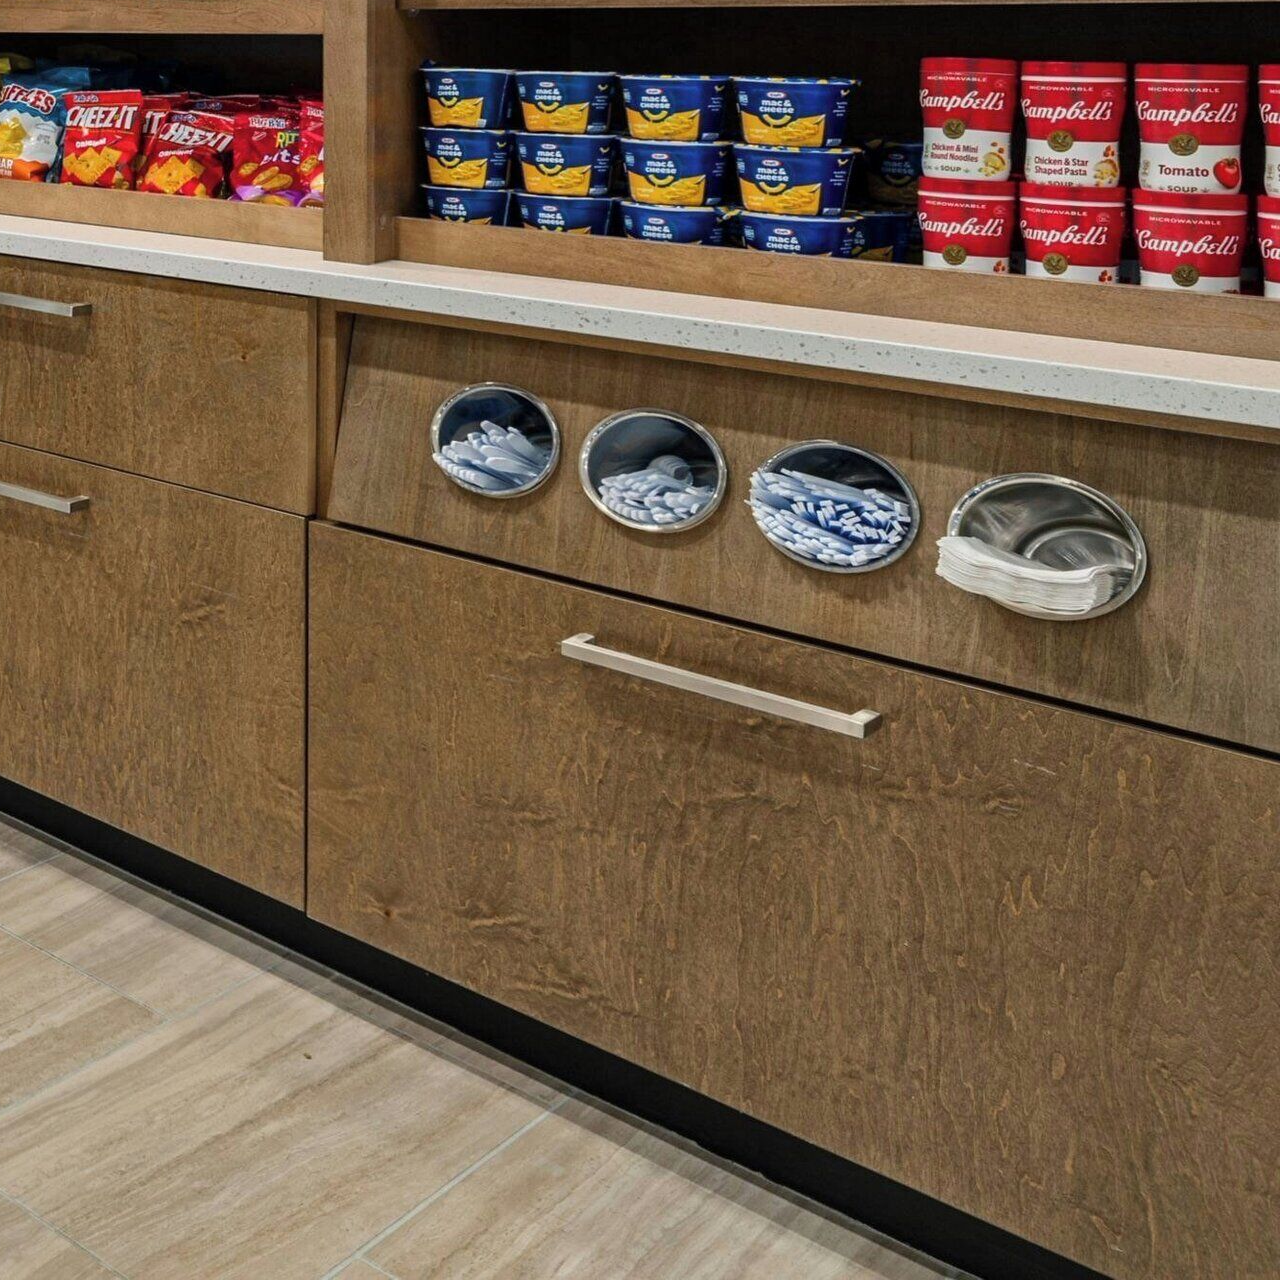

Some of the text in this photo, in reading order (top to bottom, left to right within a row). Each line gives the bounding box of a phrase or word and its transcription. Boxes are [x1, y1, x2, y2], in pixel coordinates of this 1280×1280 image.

[535, 87, 553, 95] mac
[919, 88, 1004, 112] Campbell's
[1020, 98, 1113, 122] Campbell's
[1136, 100, 1238, 127] Campbell's
[537, 150, 554, 158] mac
[931, 143, 955, 153] Chicken
[962, 144, 979, 154] Mini
[930, 152, 979, 163] Round Noodles
[1035, 156, 1062, 166] Chicken
[1071, 158, 1089, 167] Star
[1034, 166, 1088, 177] Shaped Pasta
[1158, 163, 1210, 178] Tomato
[1167, 185, 1198, 193] SOUP
[925, 200, 986, 209] MICROWAVABLE
[1025, 207, 1088, 217] MICROWAVABLE
[917, 211, 1003, 237] Campbell's
[1148, 216, 1221, 226] MICROWAVABLE
[1019, 219, 1108, 246] Campbell's
[1136, 228, 1239, 257] Campbell's
